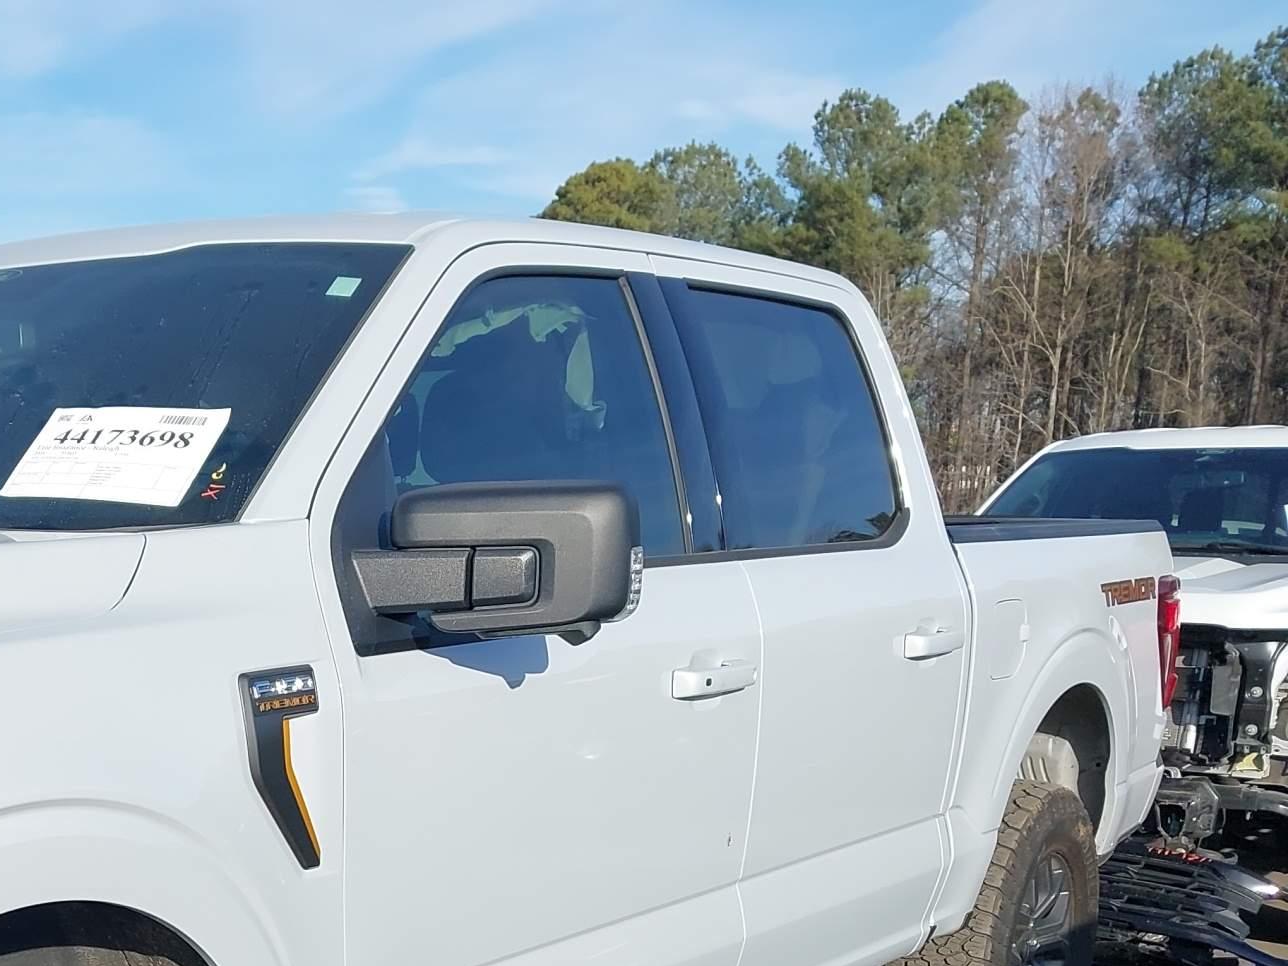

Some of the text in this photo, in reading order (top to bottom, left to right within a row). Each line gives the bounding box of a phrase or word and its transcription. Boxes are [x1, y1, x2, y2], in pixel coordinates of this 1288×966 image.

[54, 428, 194, 449] 44173698
[1100, 576, 1156, 607] TREMOR
[256, 694, 314, 712] TREMOR
